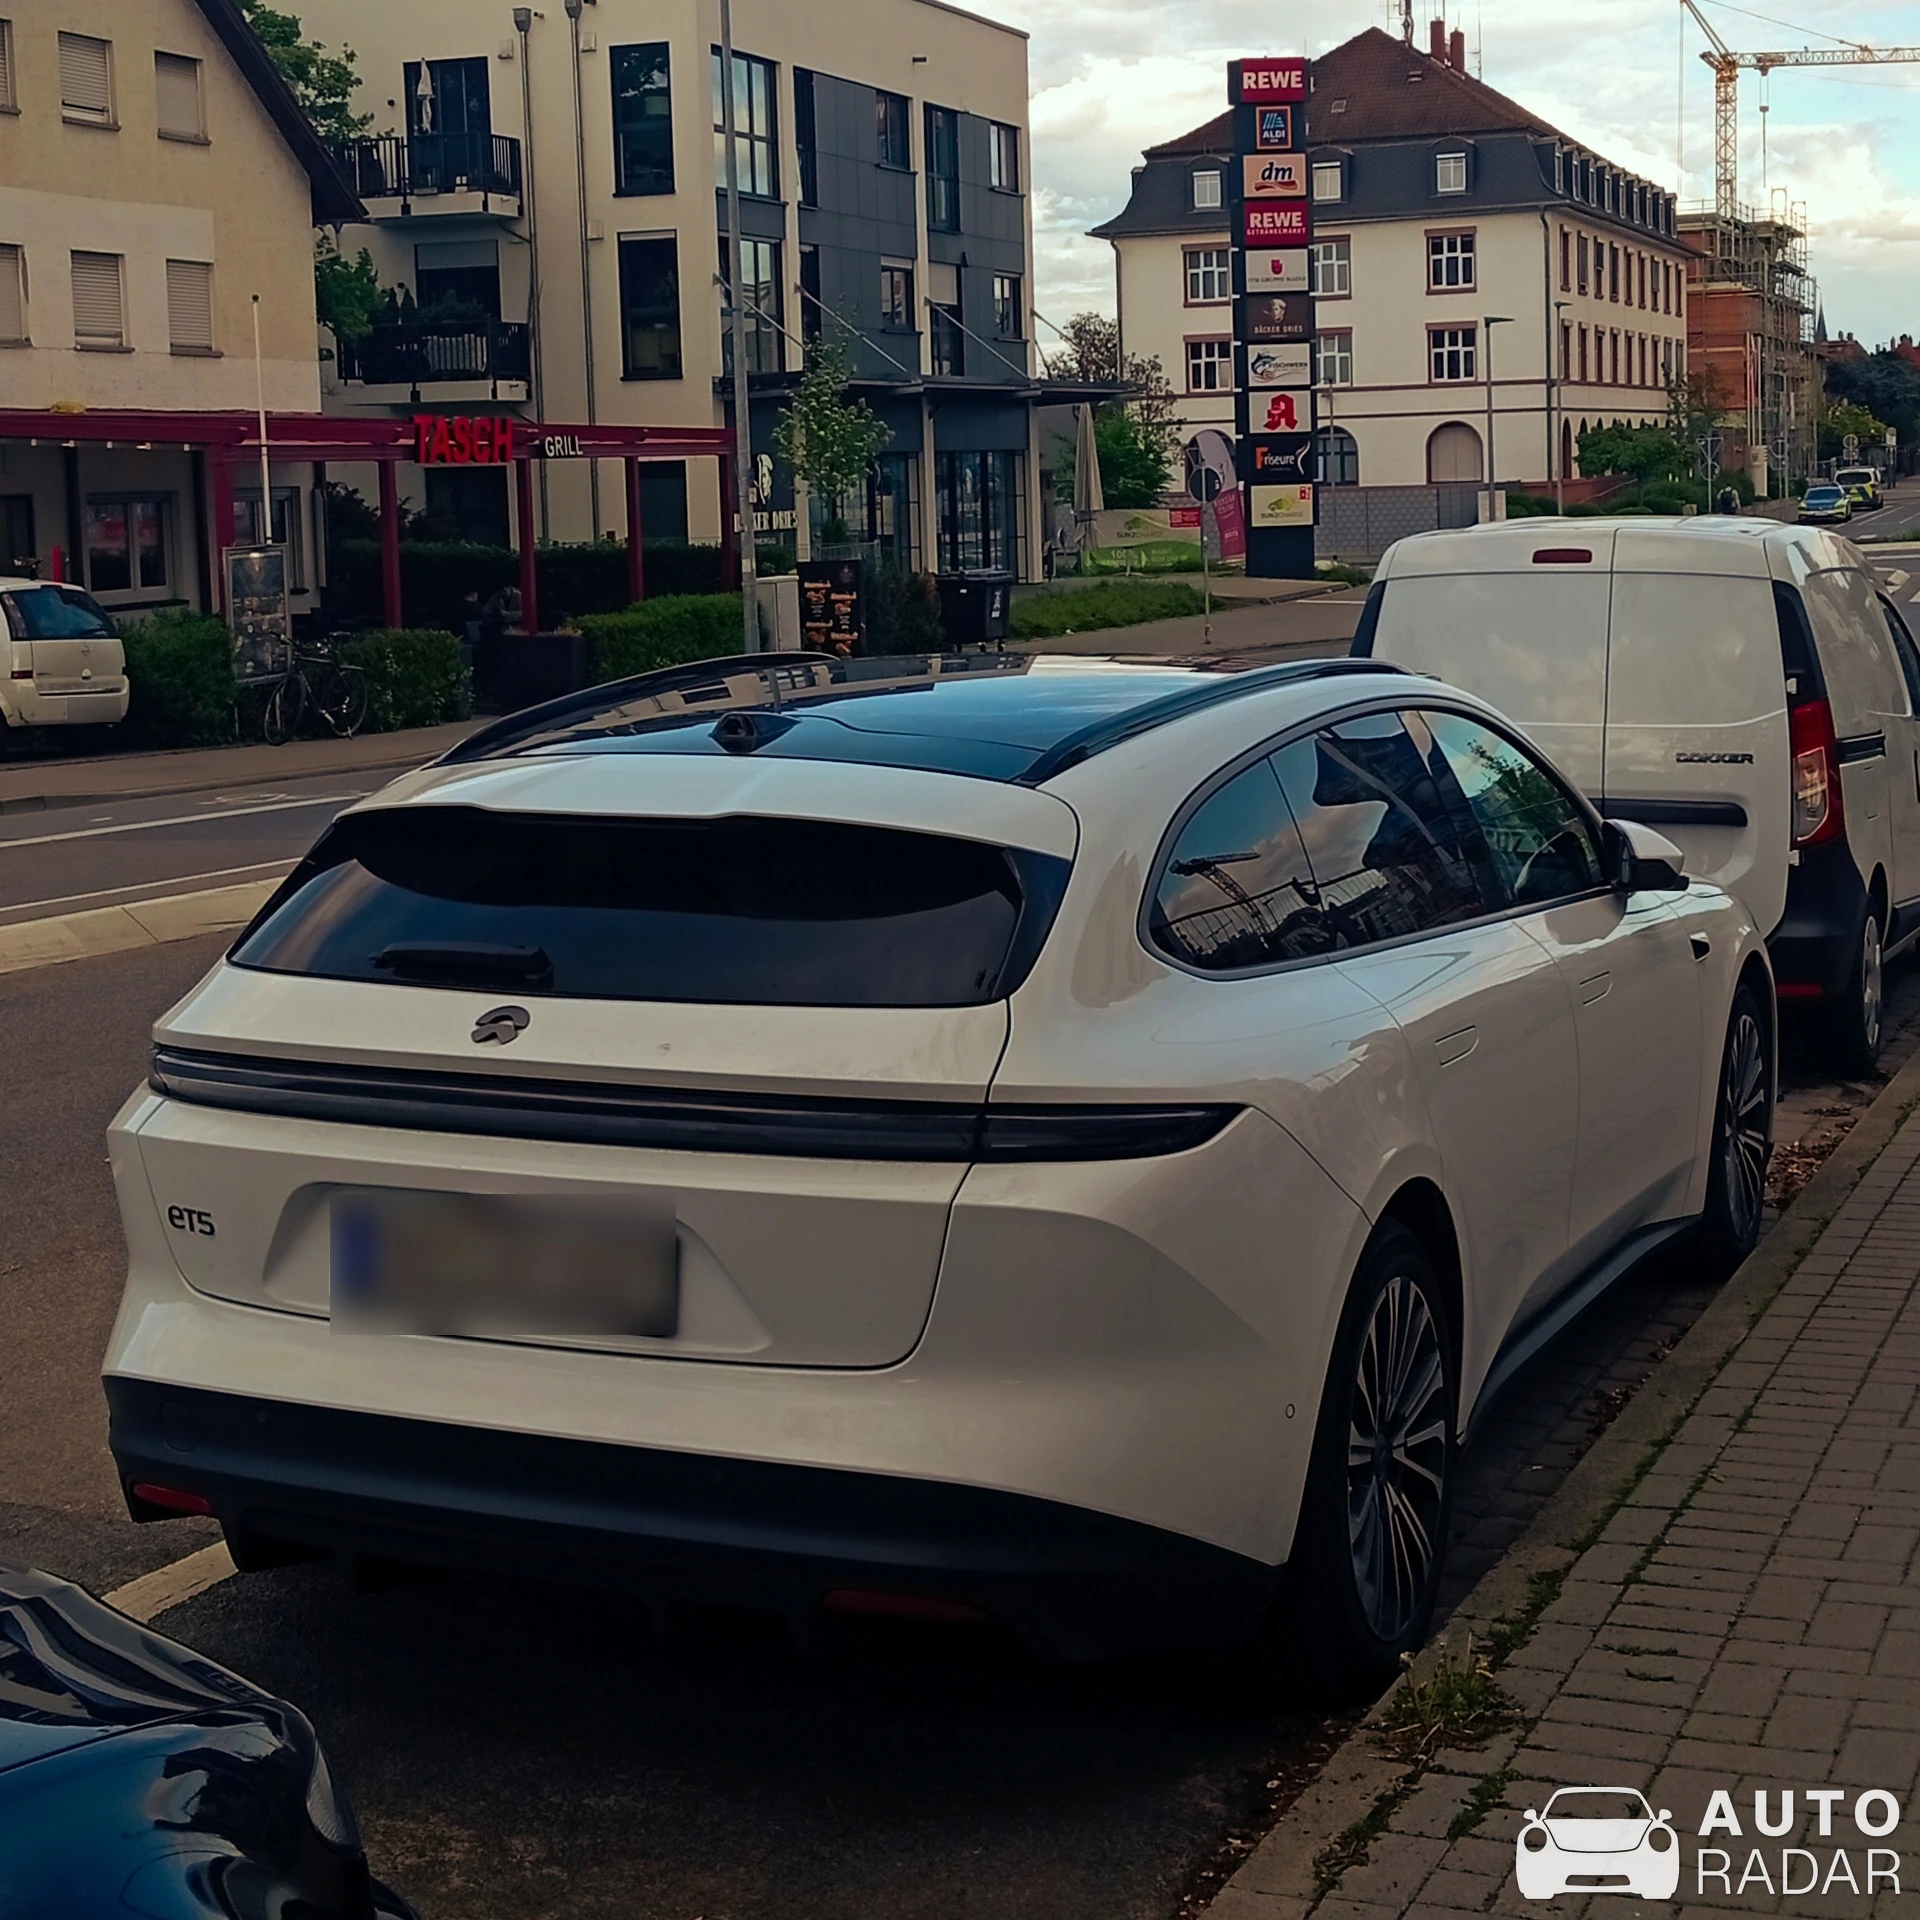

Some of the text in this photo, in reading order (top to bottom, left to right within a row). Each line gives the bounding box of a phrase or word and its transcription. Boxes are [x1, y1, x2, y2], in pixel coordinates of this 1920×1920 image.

[1242, 71, 1303, 89] REWE
[1262, 130, 1286, 139] ALDI
[1261, 161, 1293, 181] dm
[1250, 212, 1303, 228] REWE
[412, 414, 514, 464] TASCH
[544, 435, 584, 457] GRILL
[1255, 446, 1296, 470] Friseure
[1676, 752, 1754, 764] DOKKER
